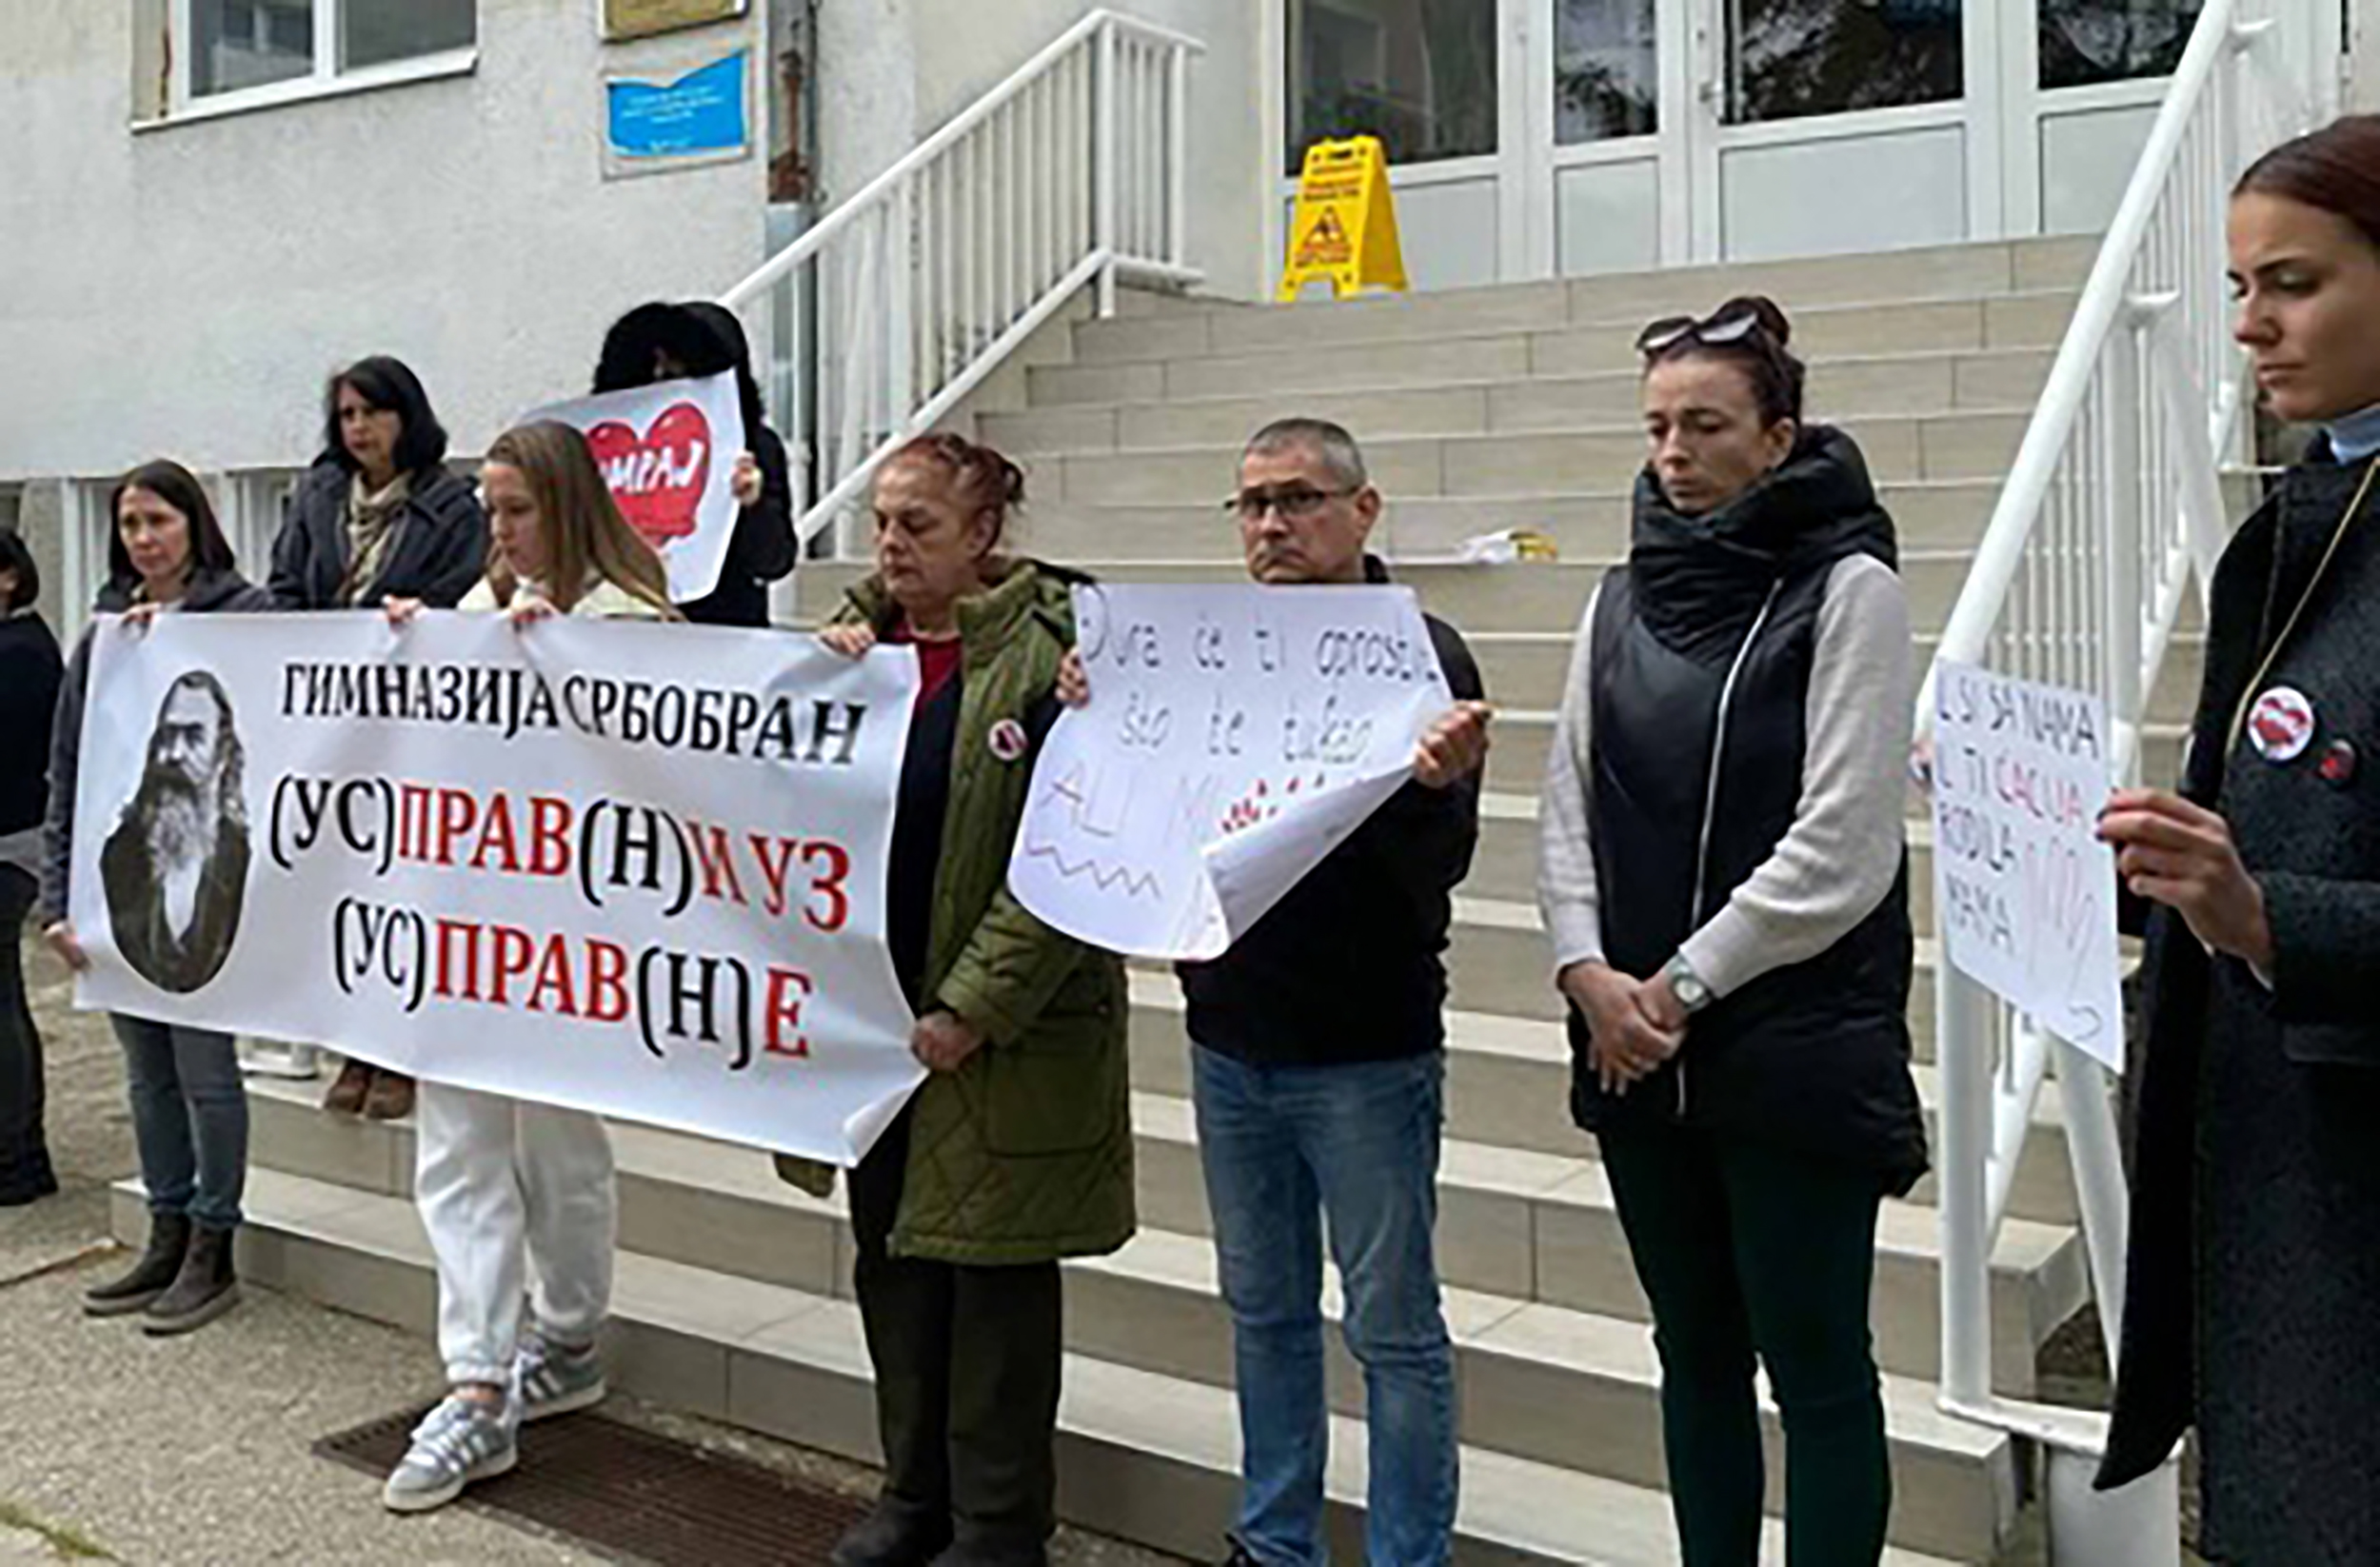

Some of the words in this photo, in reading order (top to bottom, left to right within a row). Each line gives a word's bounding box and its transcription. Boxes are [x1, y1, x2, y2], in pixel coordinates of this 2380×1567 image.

[282, 663, 560, 740] ГИМНАЗИЈА
[564, 675, 867, 764] СРБОБРАН
[270, 775, 748, 917] (УС)ПРАВ(Н)И
[748, 833, 851, 933] УЗ
[334, 897, 814, 1070] (УС)ПРАВ(Н)Е
